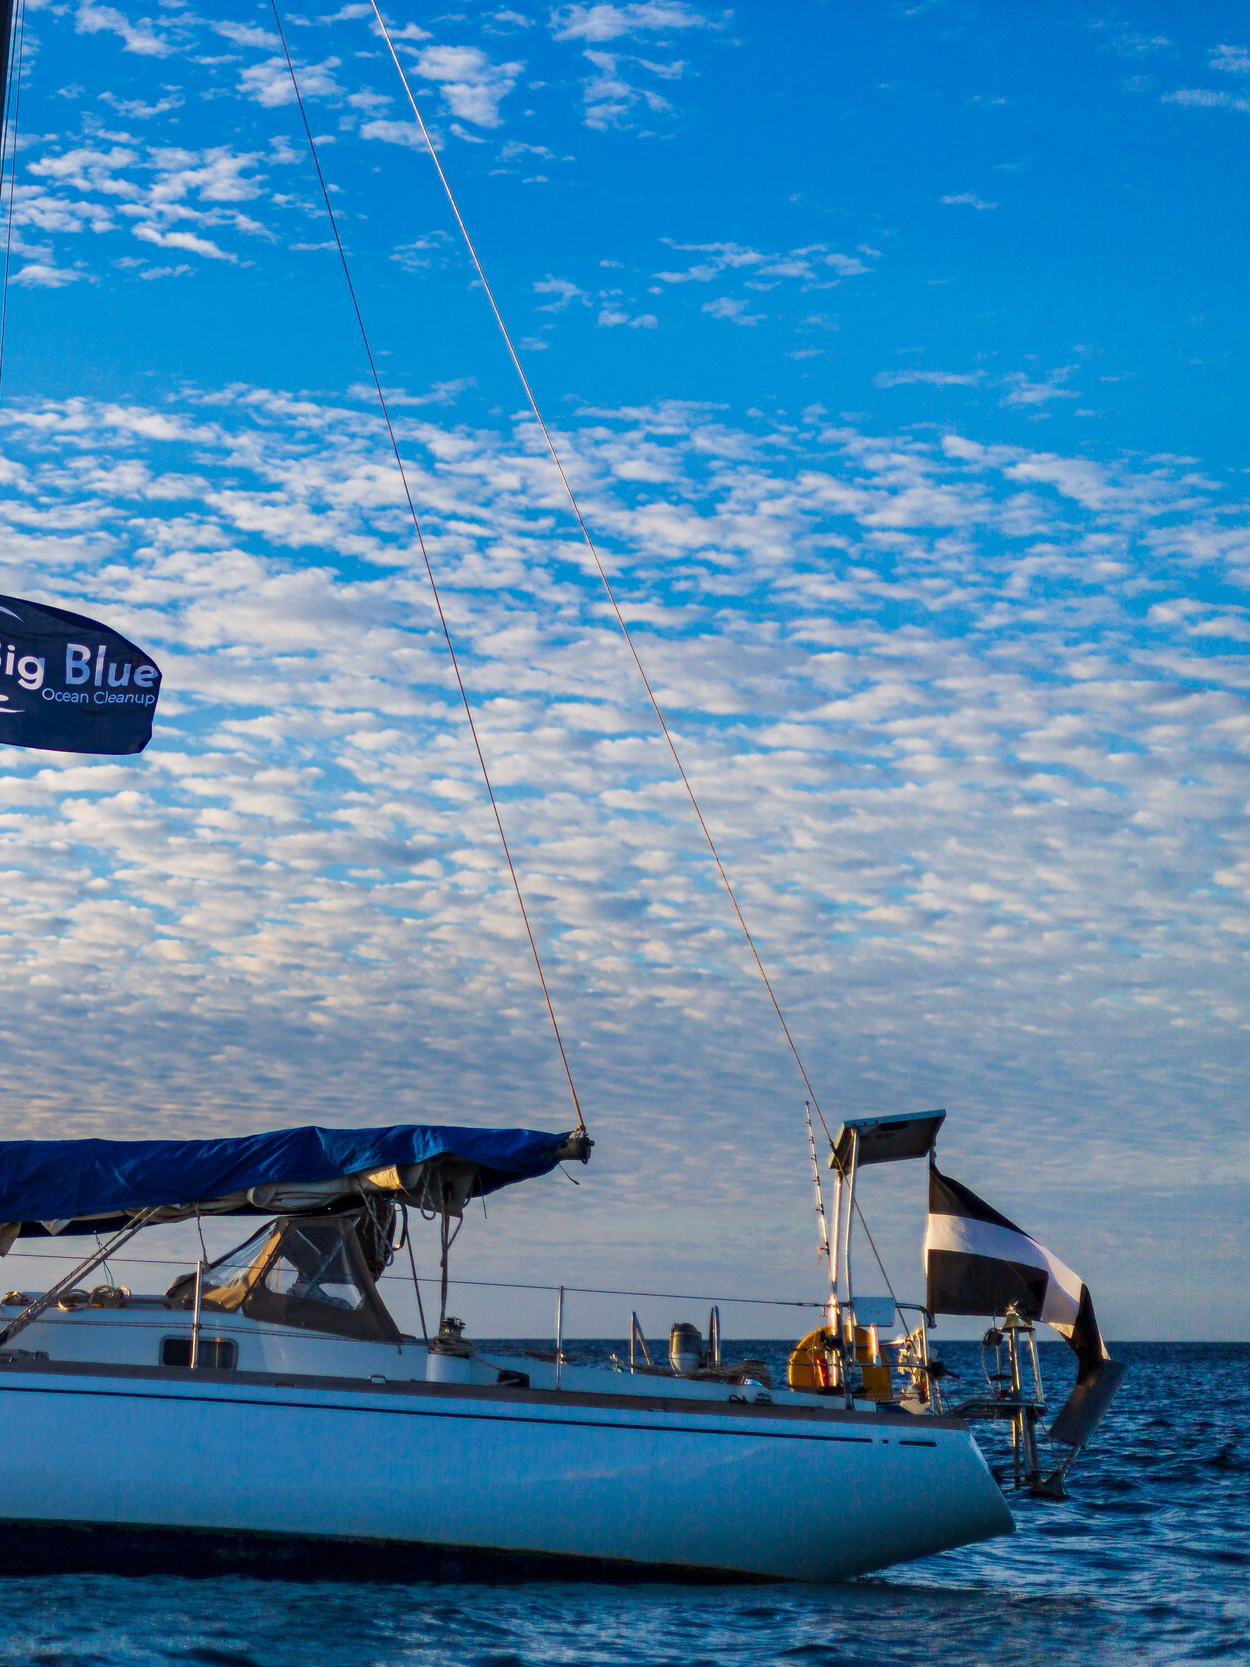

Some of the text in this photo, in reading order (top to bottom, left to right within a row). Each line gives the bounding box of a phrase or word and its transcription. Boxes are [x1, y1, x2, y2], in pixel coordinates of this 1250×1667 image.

[65, 643, 159, 688] Blue
[42, 688, 155, 707] Ocean Cleanup
